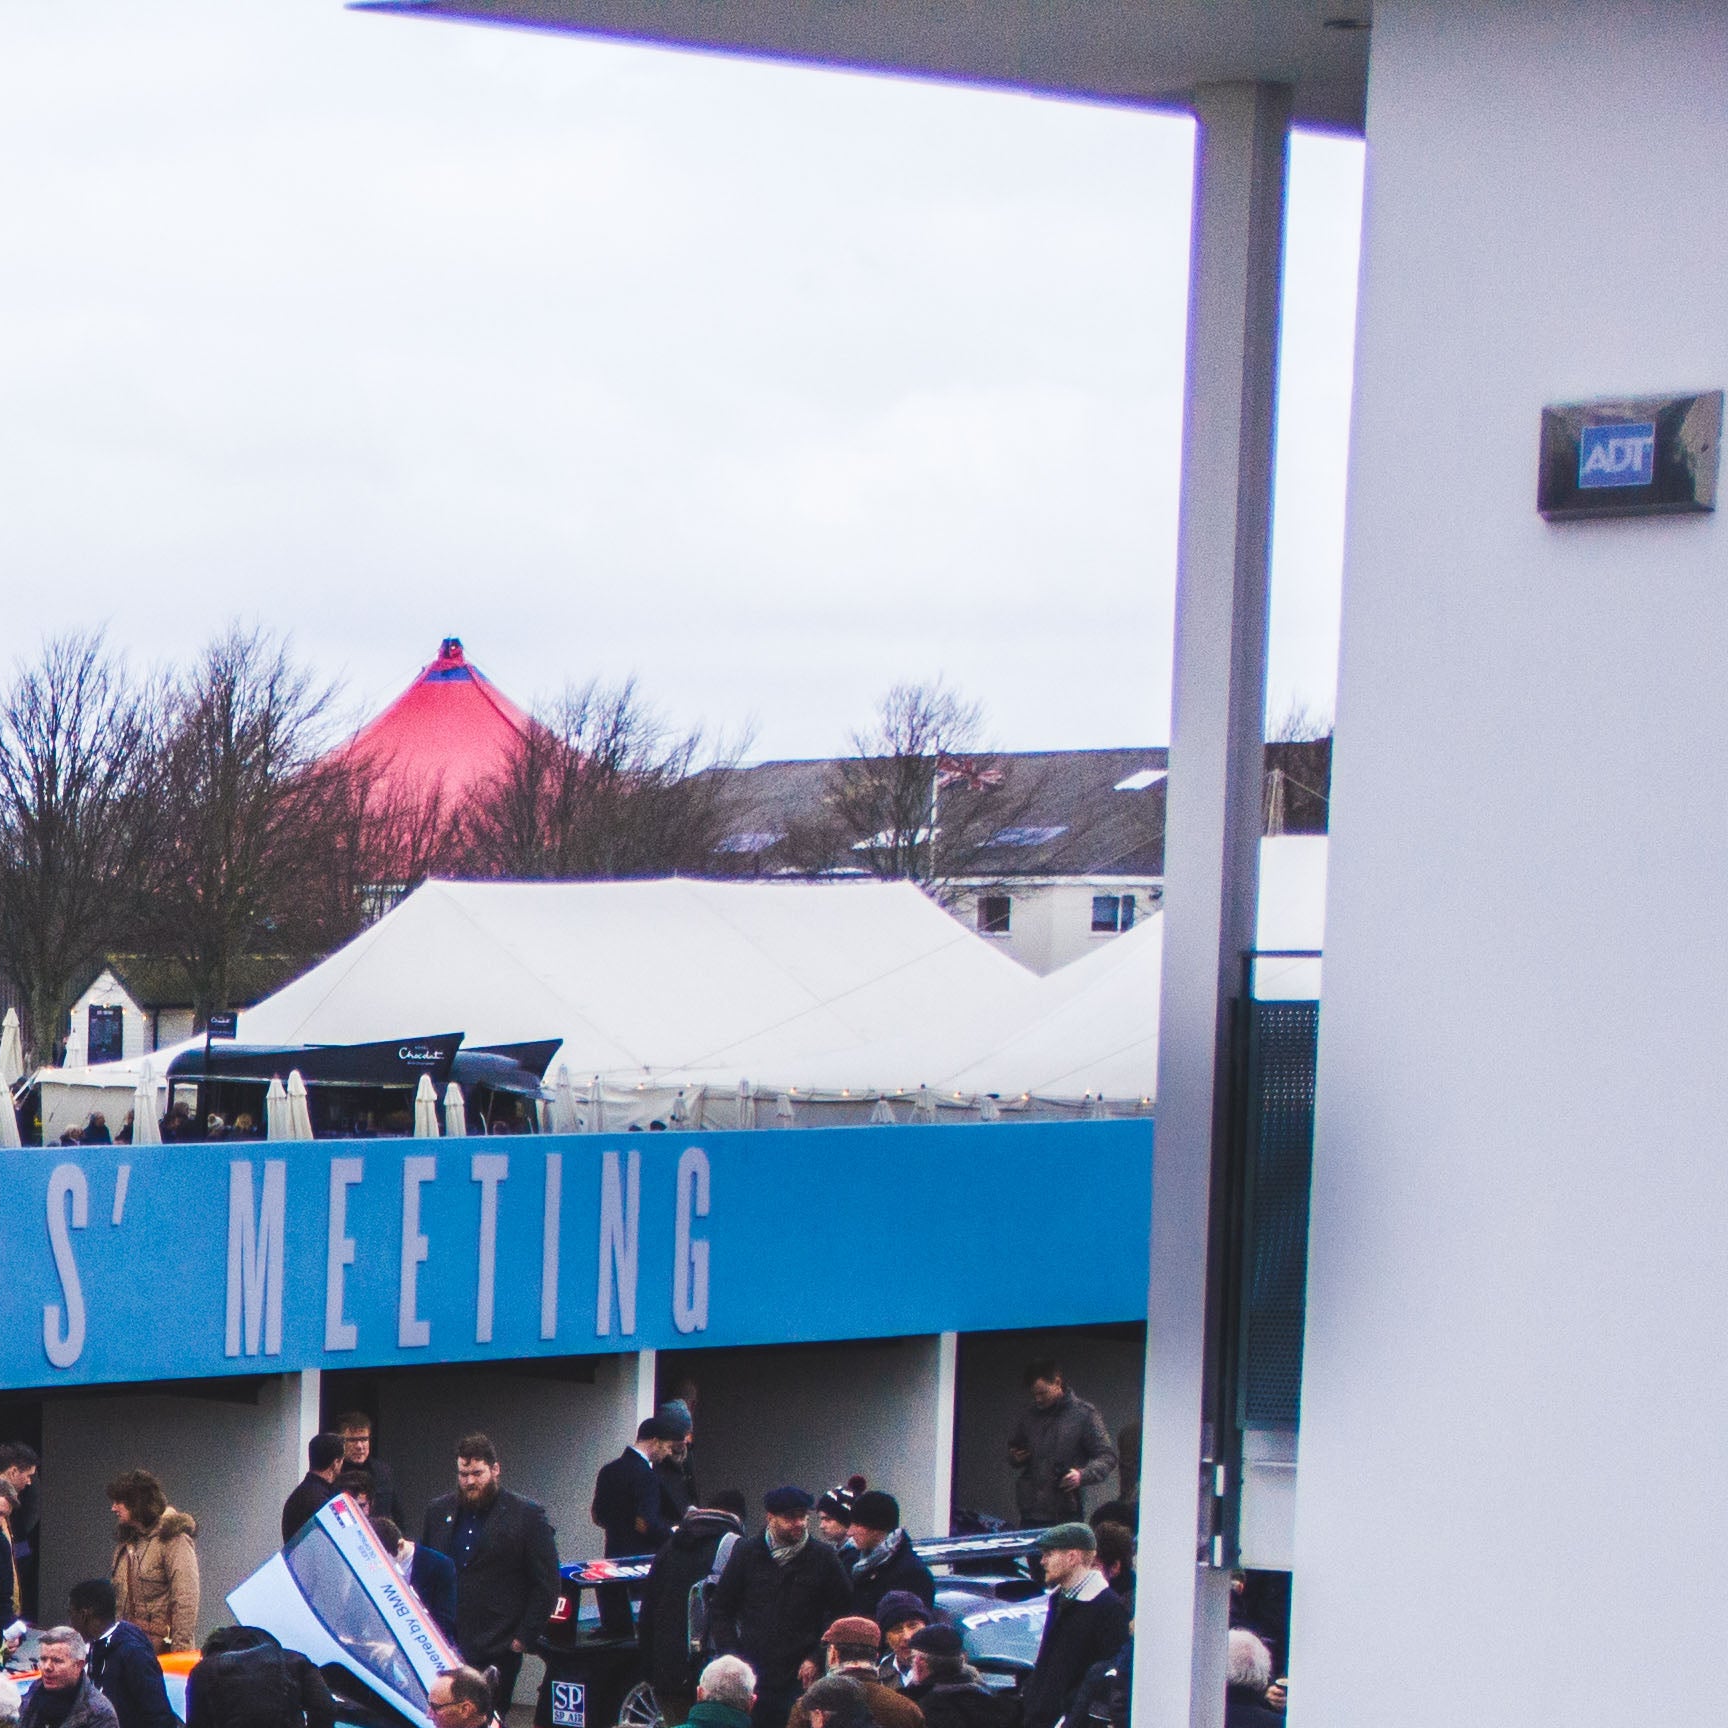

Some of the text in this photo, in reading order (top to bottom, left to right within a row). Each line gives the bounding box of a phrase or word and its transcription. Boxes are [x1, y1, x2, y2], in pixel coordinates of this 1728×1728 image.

[1581, 437, 1653, 474] ADT
[225, 1145, 712, 1361] MEETING
[380, 1584, 411, 1618] BMW
[554, 1684, 582, 1711] SP
